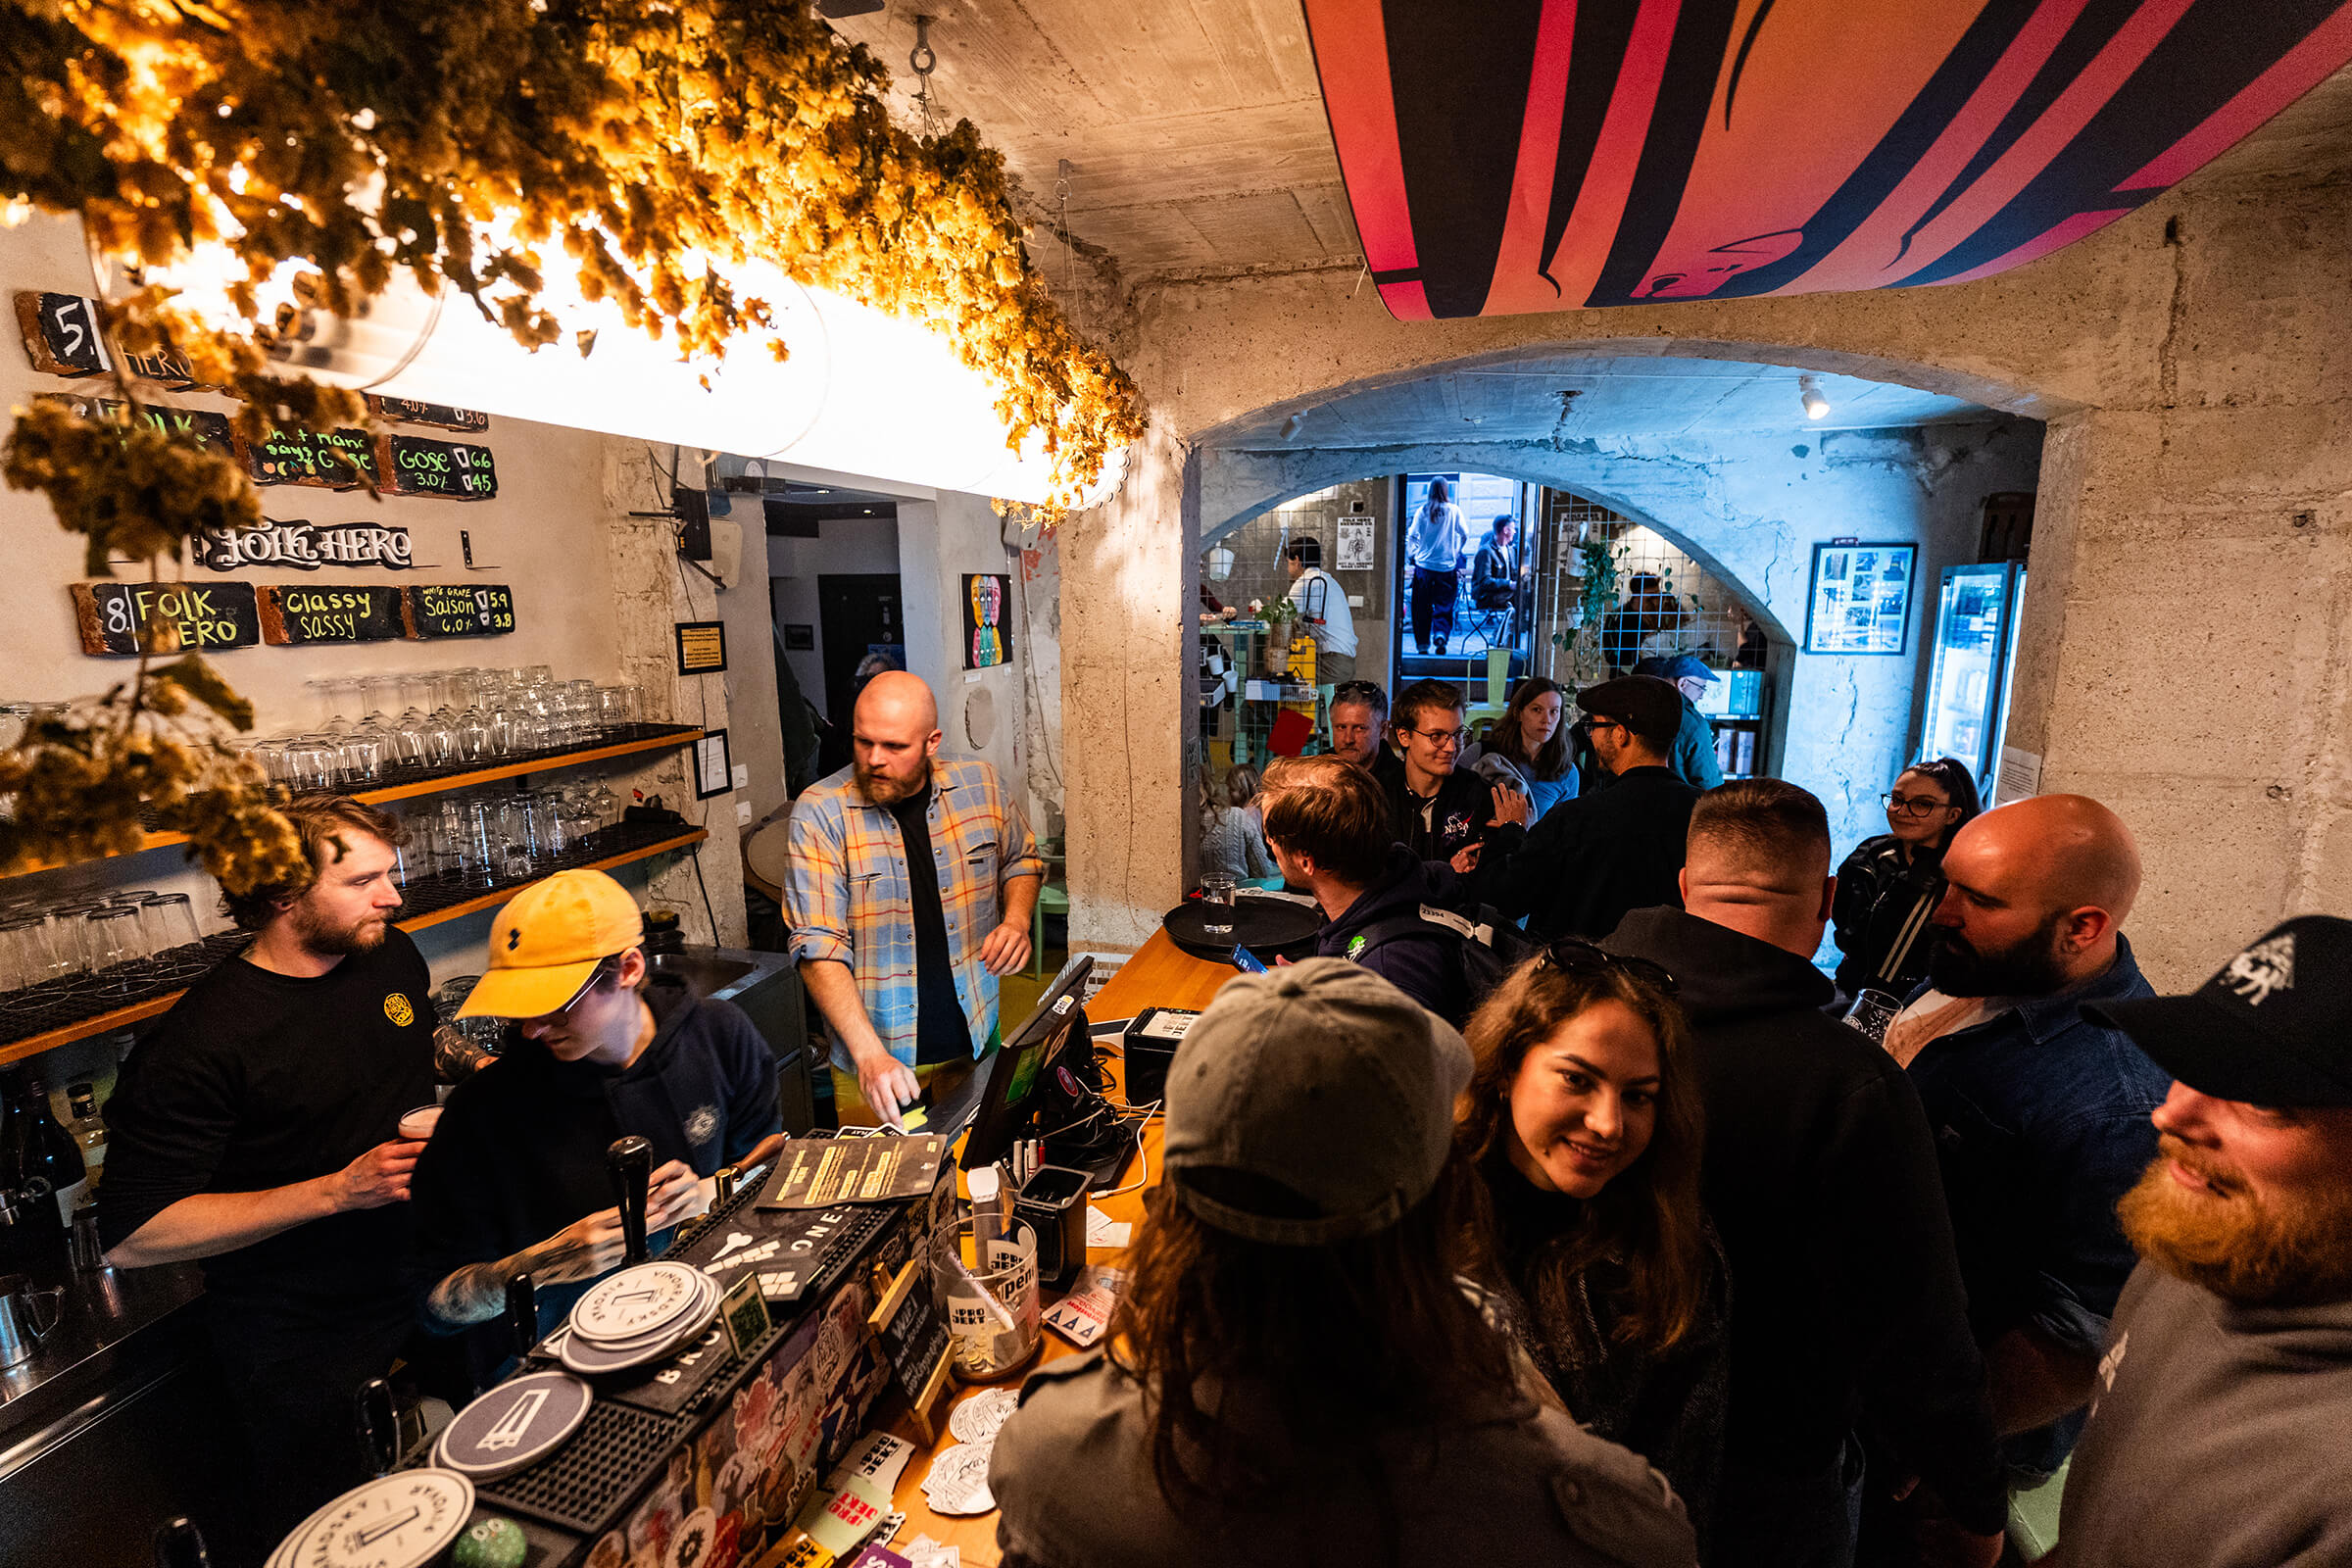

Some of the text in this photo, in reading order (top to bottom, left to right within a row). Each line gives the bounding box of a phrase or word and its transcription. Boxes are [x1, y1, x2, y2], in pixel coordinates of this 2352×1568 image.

[266, 444, 371, 469] says Gse
[218, 520, 413, 568] FOLK HERO
[135, 589, 217, 622] FOLK
[286, 592, 371, 617] Classy
[424, 595, 475, 617] Saison
[176, 619, 237, 646] ERO
[836, 1491, 878, 1521] JEKT
